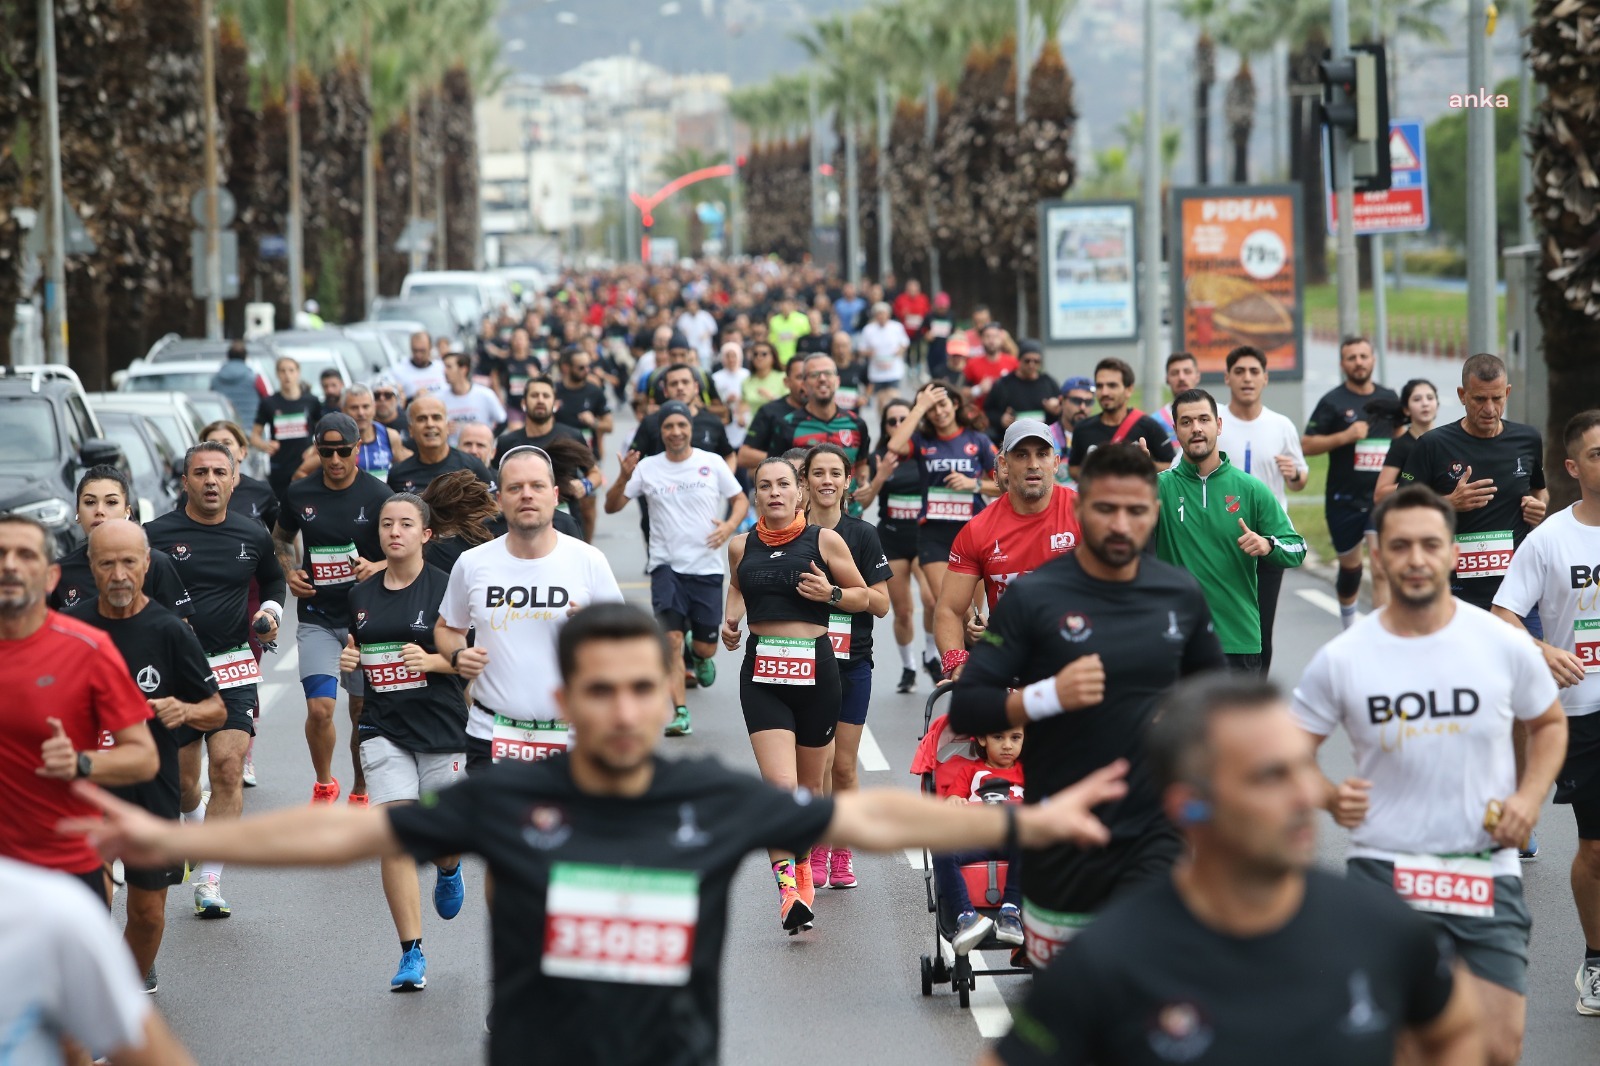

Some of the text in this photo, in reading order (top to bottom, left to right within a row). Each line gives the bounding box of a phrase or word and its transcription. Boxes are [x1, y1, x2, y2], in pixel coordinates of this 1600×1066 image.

[1202, 200, 1278, 221] PIDEM
[925, 458, 975, 473] VESTEL
[1177, 504, 1184, 522] 1
[1457, 553, 1511, 570] 35592
[485, 585, 569, 609] BOLD
[490, 597, 559, 631] Union
[757, 659, 812, 676] 35520
[1367, 688, 1480, 725] BOLD
[1396, 871, 1490, 903] 36640
[550, 916, 688, 963] 35089
